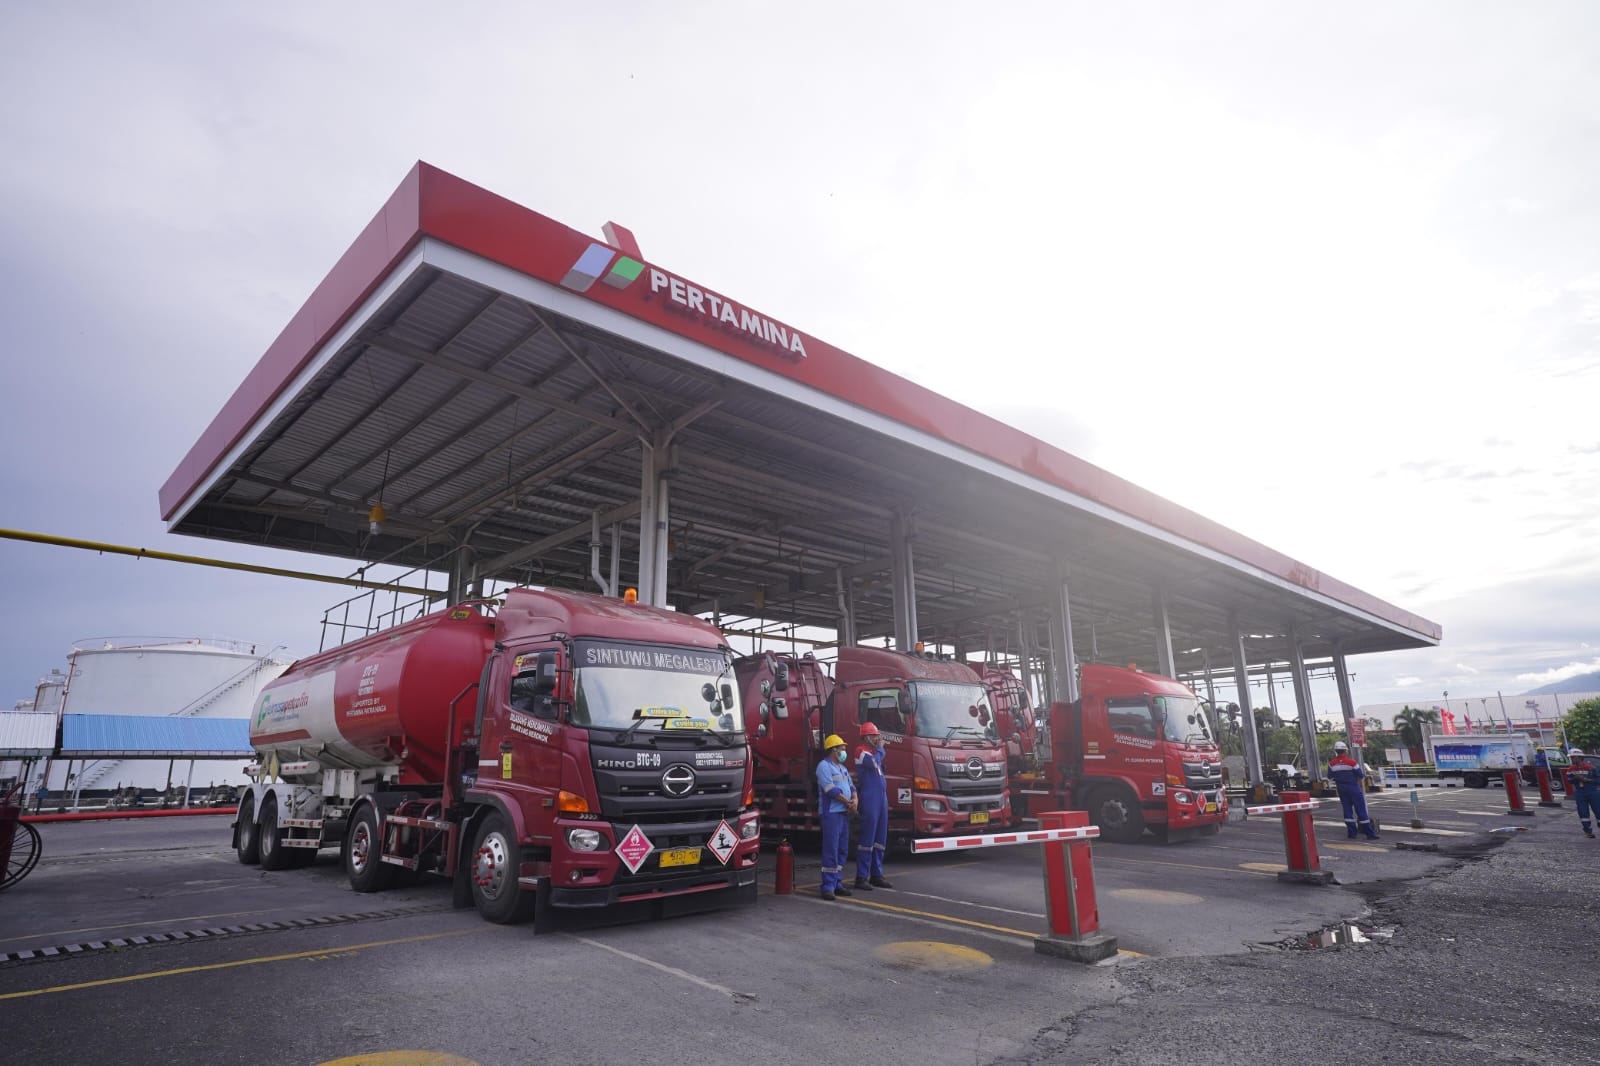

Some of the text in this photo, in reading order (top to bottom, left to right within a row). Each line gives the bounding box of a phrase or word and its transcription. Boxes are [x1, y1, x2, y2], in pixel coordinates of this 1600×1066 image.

[650, 268, 807, 358] PERTAMINA
[586, 648, 650, 666] SINTUWU
[598, 760, 636, 768] HINO
[636, 753, 660, 767] BTG-09
